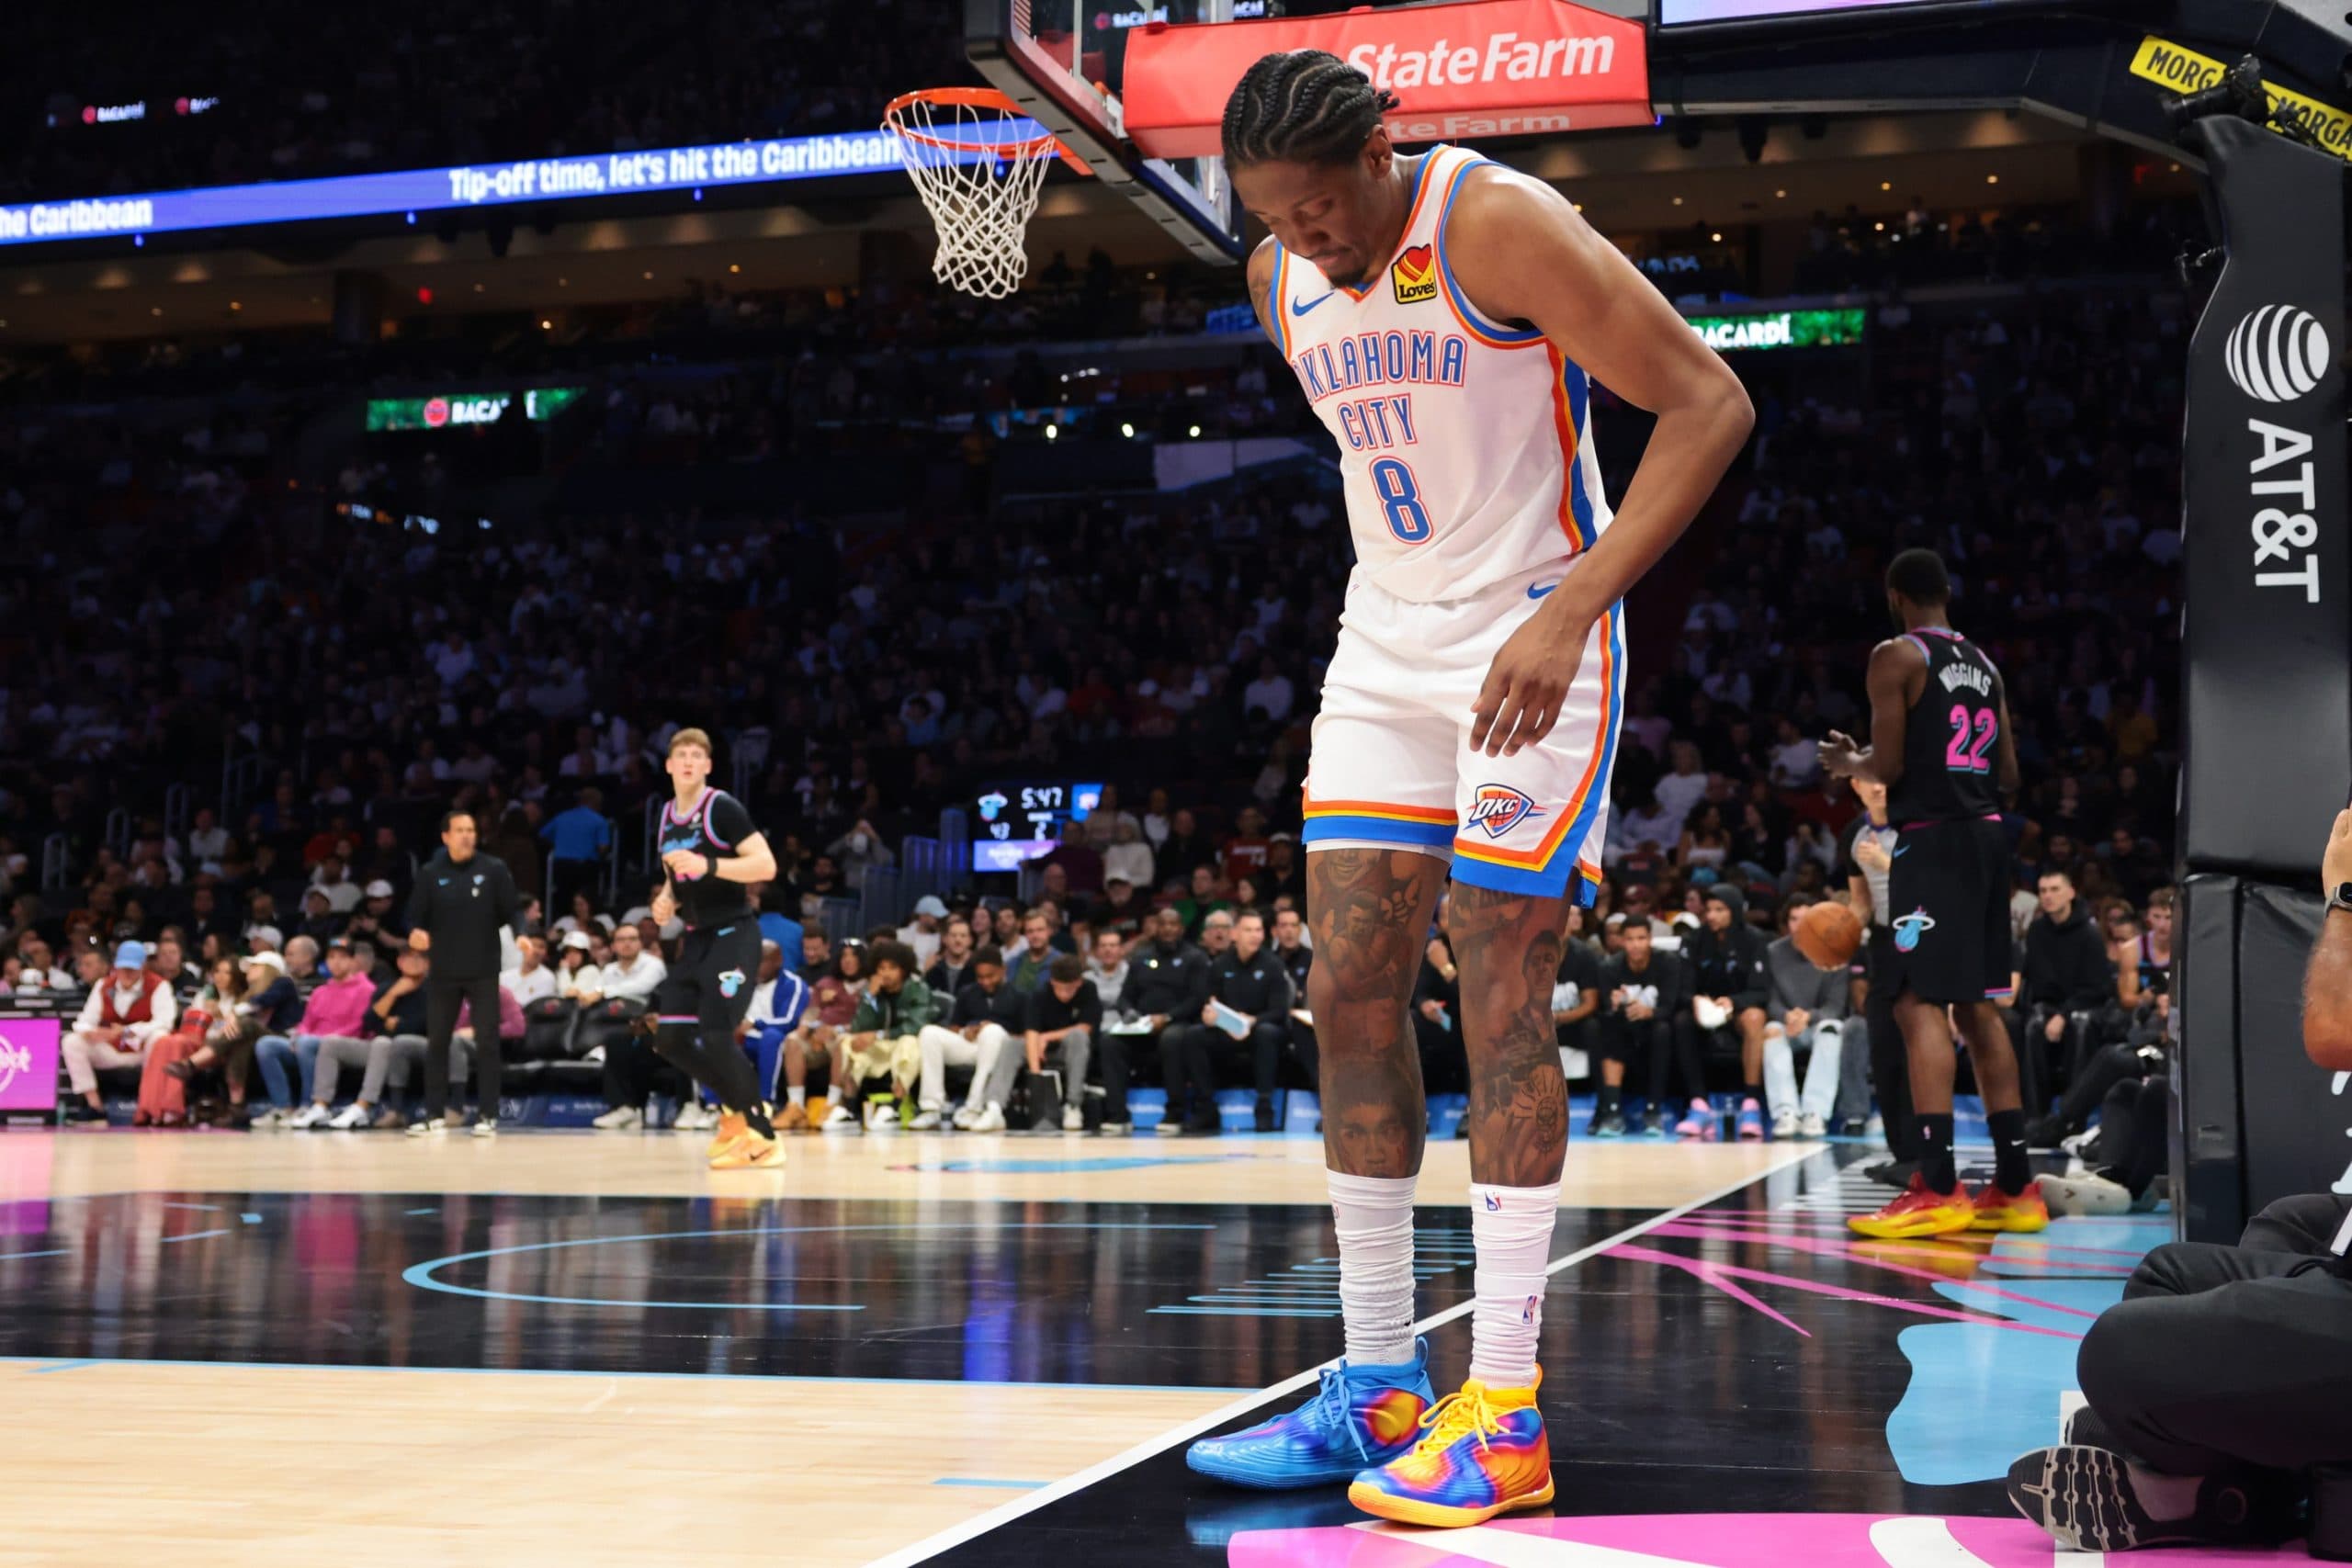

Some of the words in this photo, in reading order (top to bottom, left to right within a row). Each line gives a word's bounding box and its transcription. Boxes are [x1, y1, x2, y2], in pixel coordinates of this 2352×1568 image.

[1481, 32, 1614, 82] Farm
[2147, 46, 2217, 92] MORG
[1443, 115, 1570, 135] Farm
[2278, 96, 2352, 151] ORGA
[448, 162, 536, 203] Tip-off
[538, 160, 605, 191] time,
[609, 154, 665, 186] let's
[670, 149, 707, 182] hit
[711, 145, 757, 178] the
[762, 137, 900, 174] Caribbean
[0, 207, 28, 238] he
[29, 198, 153, 235] Caribbean
[1291, 330, 1467, 407] KLAHOMA
[1338, 392, 1418, 451] CITY
[1369, 456, 1434, 546] 8
[2248, 418, 2320, 604] AT&T
[1939, 662, 1992, 698] WIGGINS
[1946, 704, 1999, 775] 22
[1469, 797, 1520, 822] OKC
